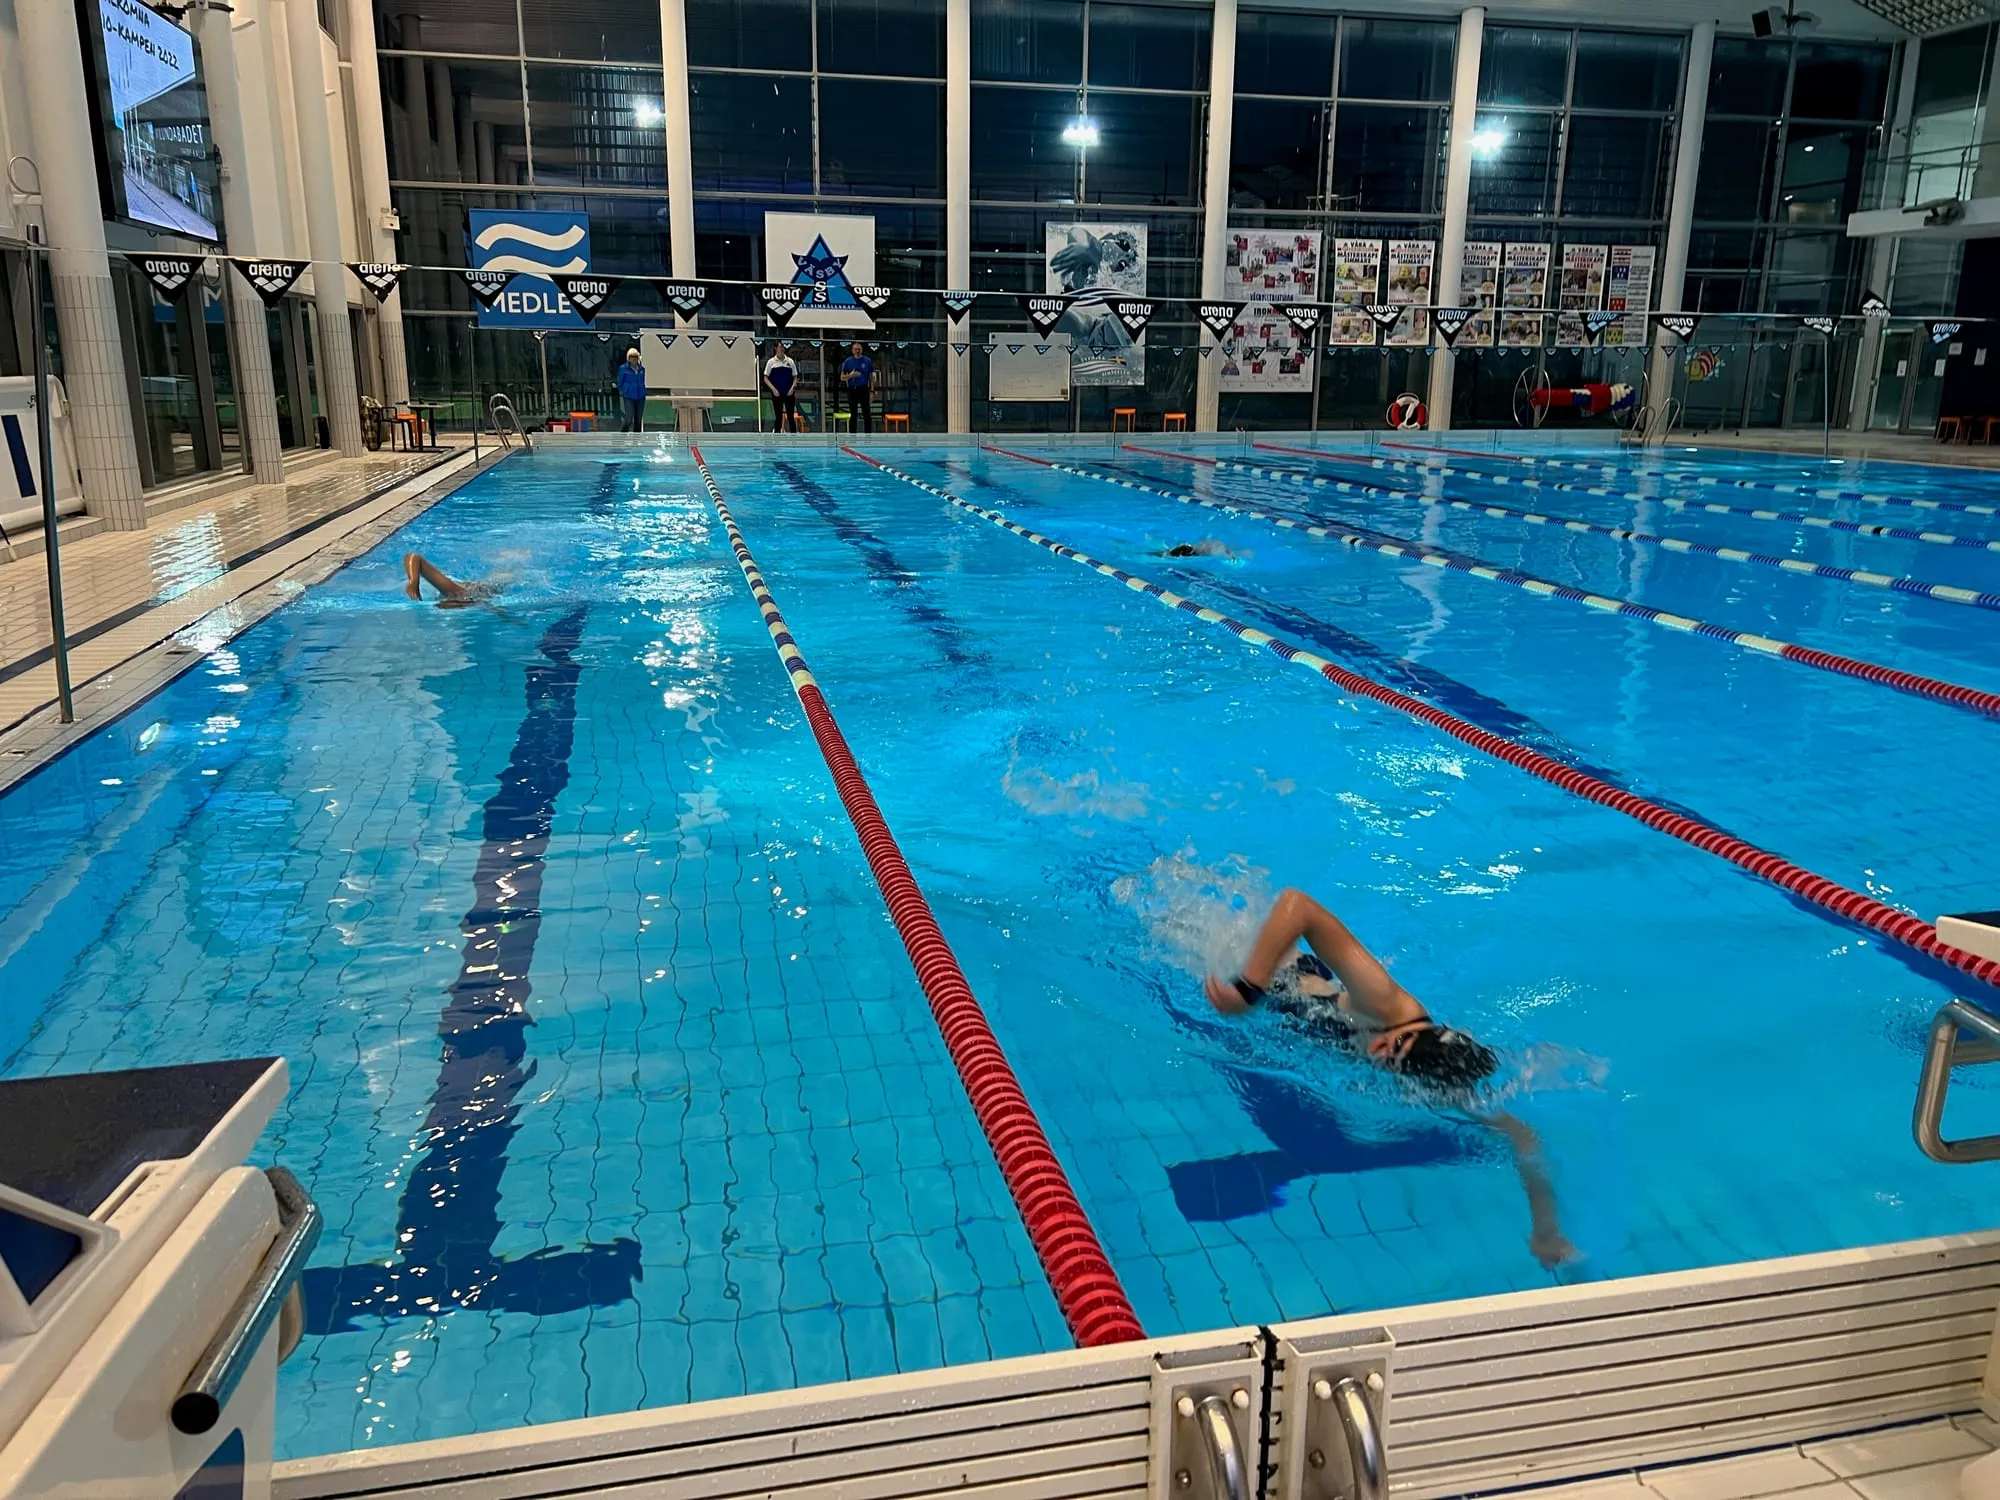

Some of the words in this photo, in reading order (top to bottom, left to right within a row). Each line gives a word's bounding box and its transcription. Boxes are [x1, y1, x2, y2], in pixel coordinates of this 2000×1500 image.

[104, 0, 150, 28] KOMNA
[157, 46, 180, 71] 2022
[145, 260, 190, 274] arena
[248, 262, 293, 278] arena
[359, 263, 401, 274] arena
[797, 257, 842, 279] VÄSBY
[466, 271, 507, 281] arena
[568, 280, 608, 294] arena
[667, 285, 705, 298] arena
[853, 286, 891, 296] arena
[762, 287, 801, 300] arena
[485, 292, 572, 313] MEDLE
[1029, 299, 1063, 311] arena
[1118, 303, 1152, 315] arena
[1201, 306, 1234, 318] arena
[1286, 308, 1318, 318] arena
[1437, 310, 1468, 320] arena
[1663, 317, 1694, 326] arena
[1933, 323, 1961, 333] arena
